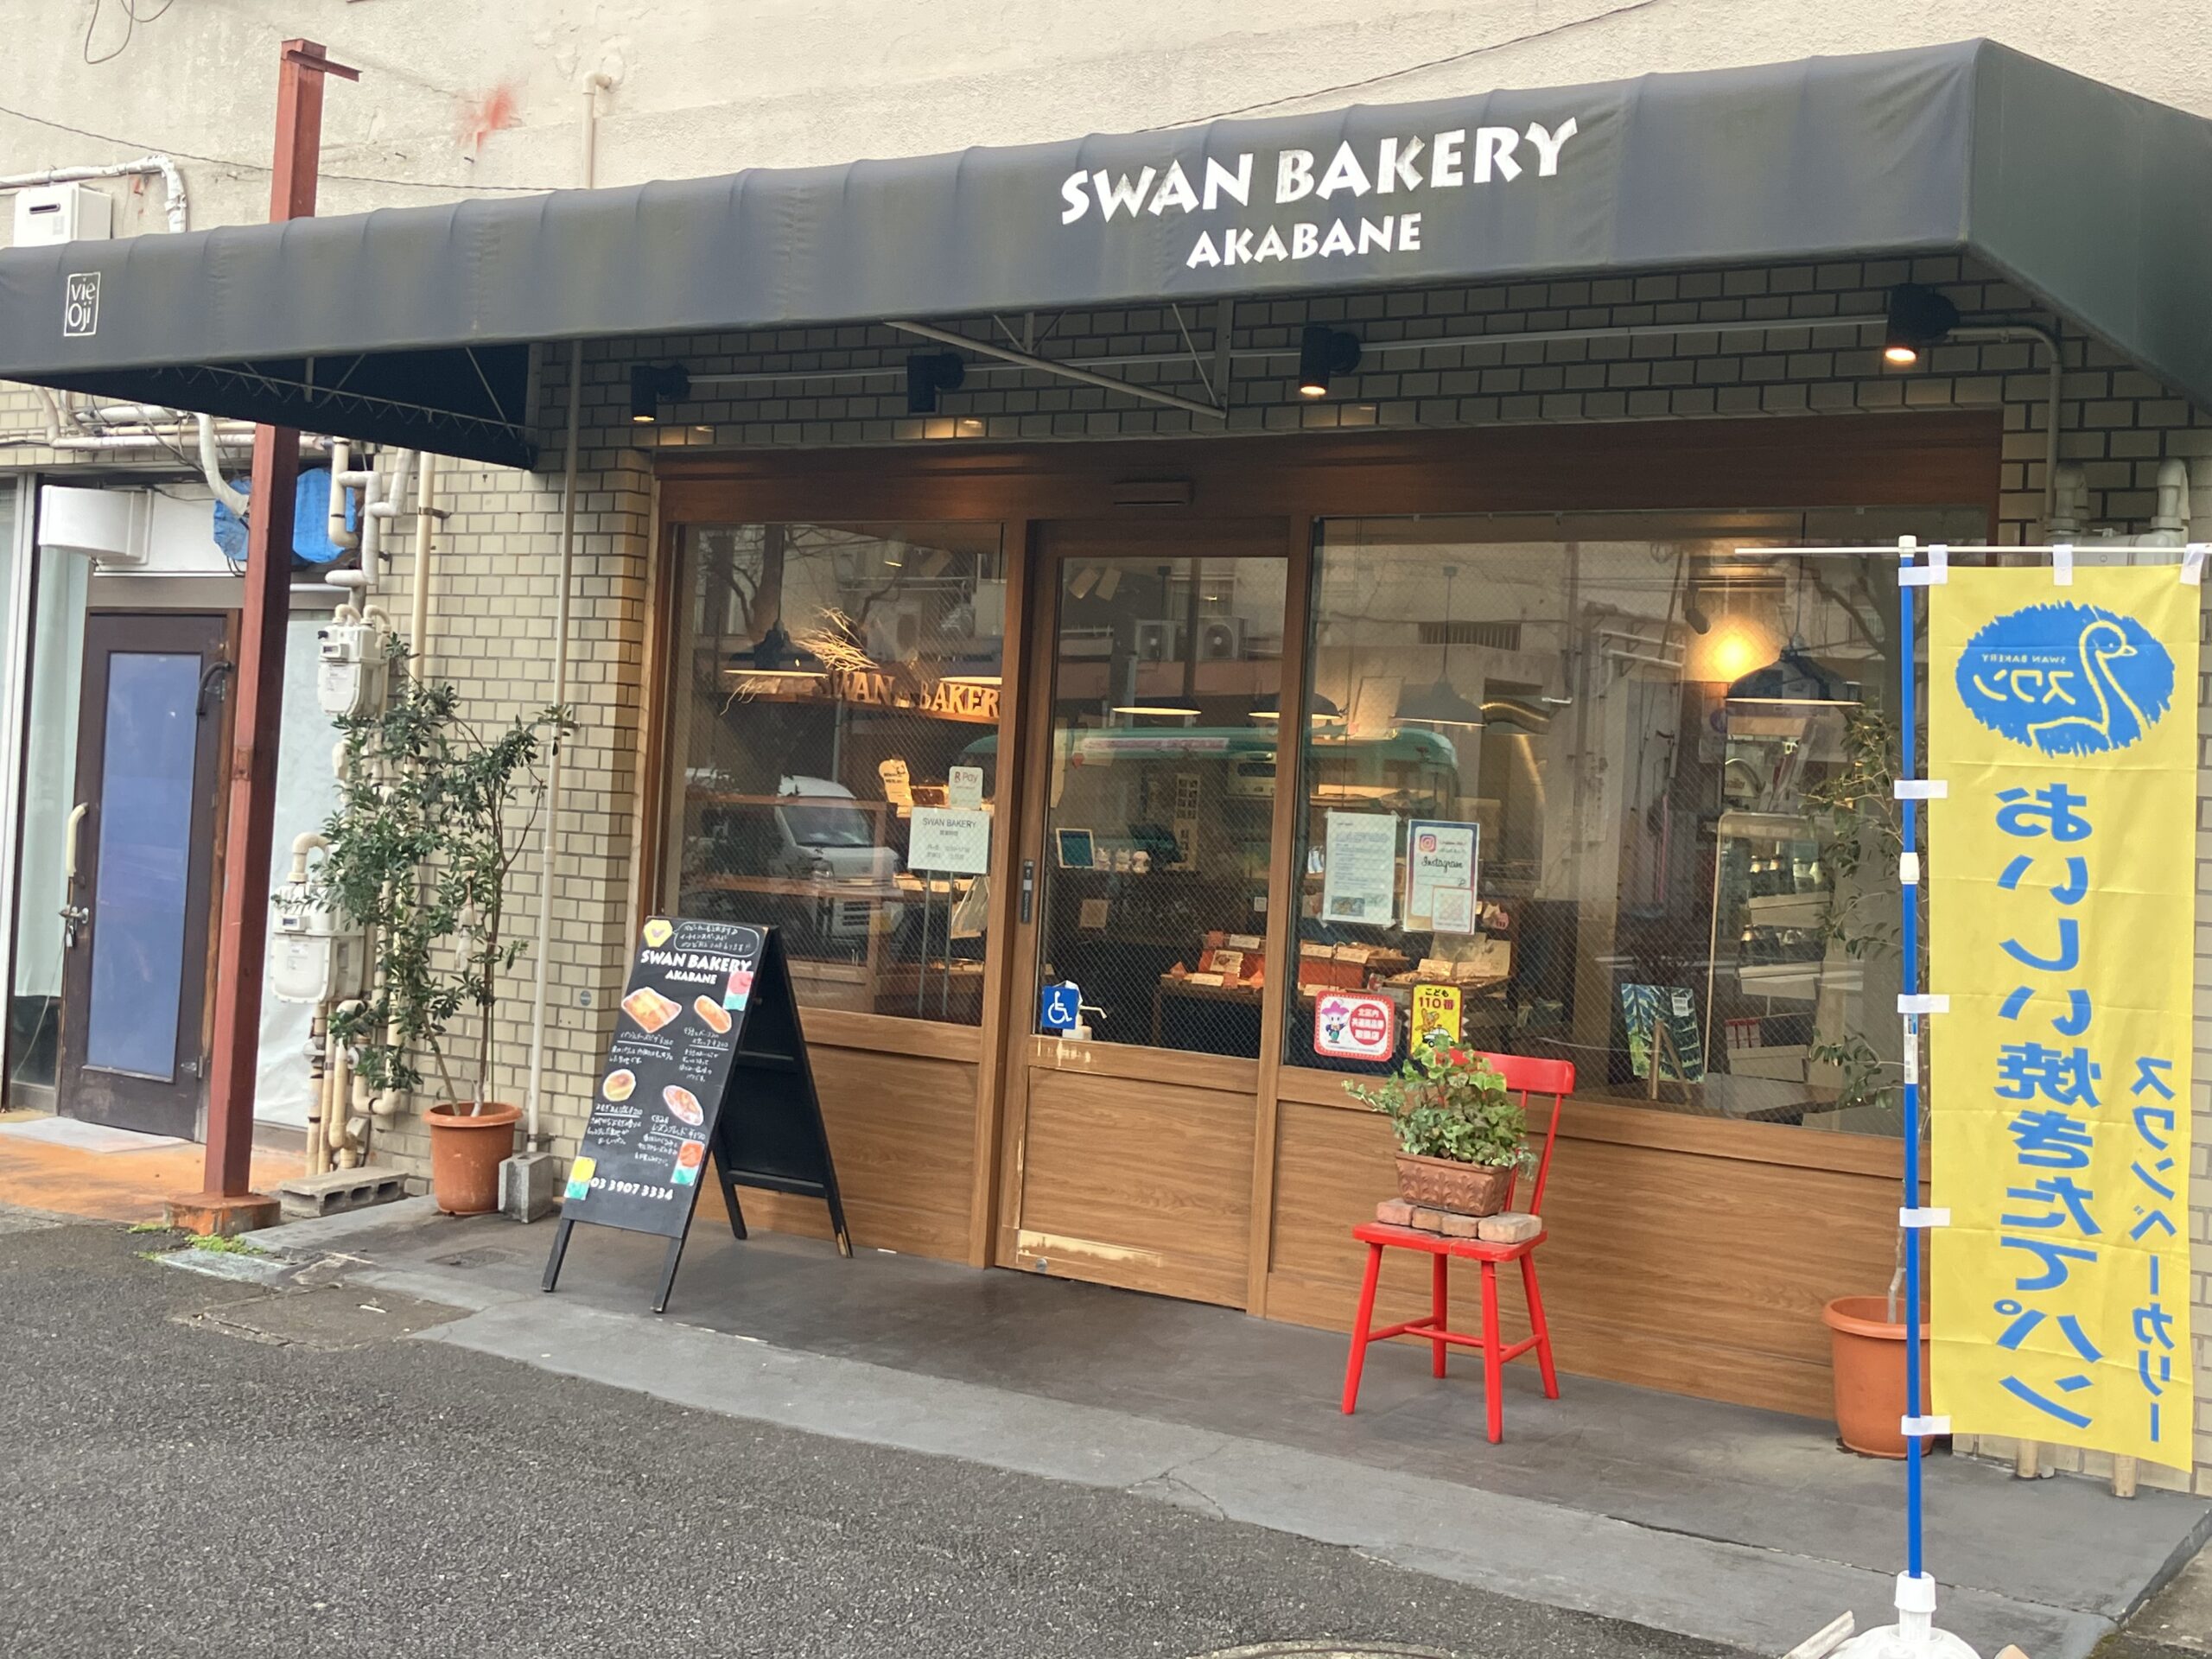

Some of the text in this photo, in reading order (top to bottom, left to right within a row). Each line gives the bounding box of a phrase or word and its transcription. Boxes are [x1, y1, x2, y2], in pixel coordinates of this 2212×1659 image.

[1061, 117, 1577, 226] SWAN BAKERY
[1185, 212, 1422, 270] AKABANE
[71, 276, 96, 301] vie
[68, 301, 92, 332] Oji
[922, 817, 977, 829] SWAN BAKERY
[1421, 856, 1463, 873] Instagram
[640, 950, 753, 974] SWAN BAKERY
[664, 969, 718, 985] AKABANE
[1418, 996, 1454, 1010] 110番
[1425, 988, 1450, 997] こども
[590, 1177, 674, 1201] 03 3907 3334
